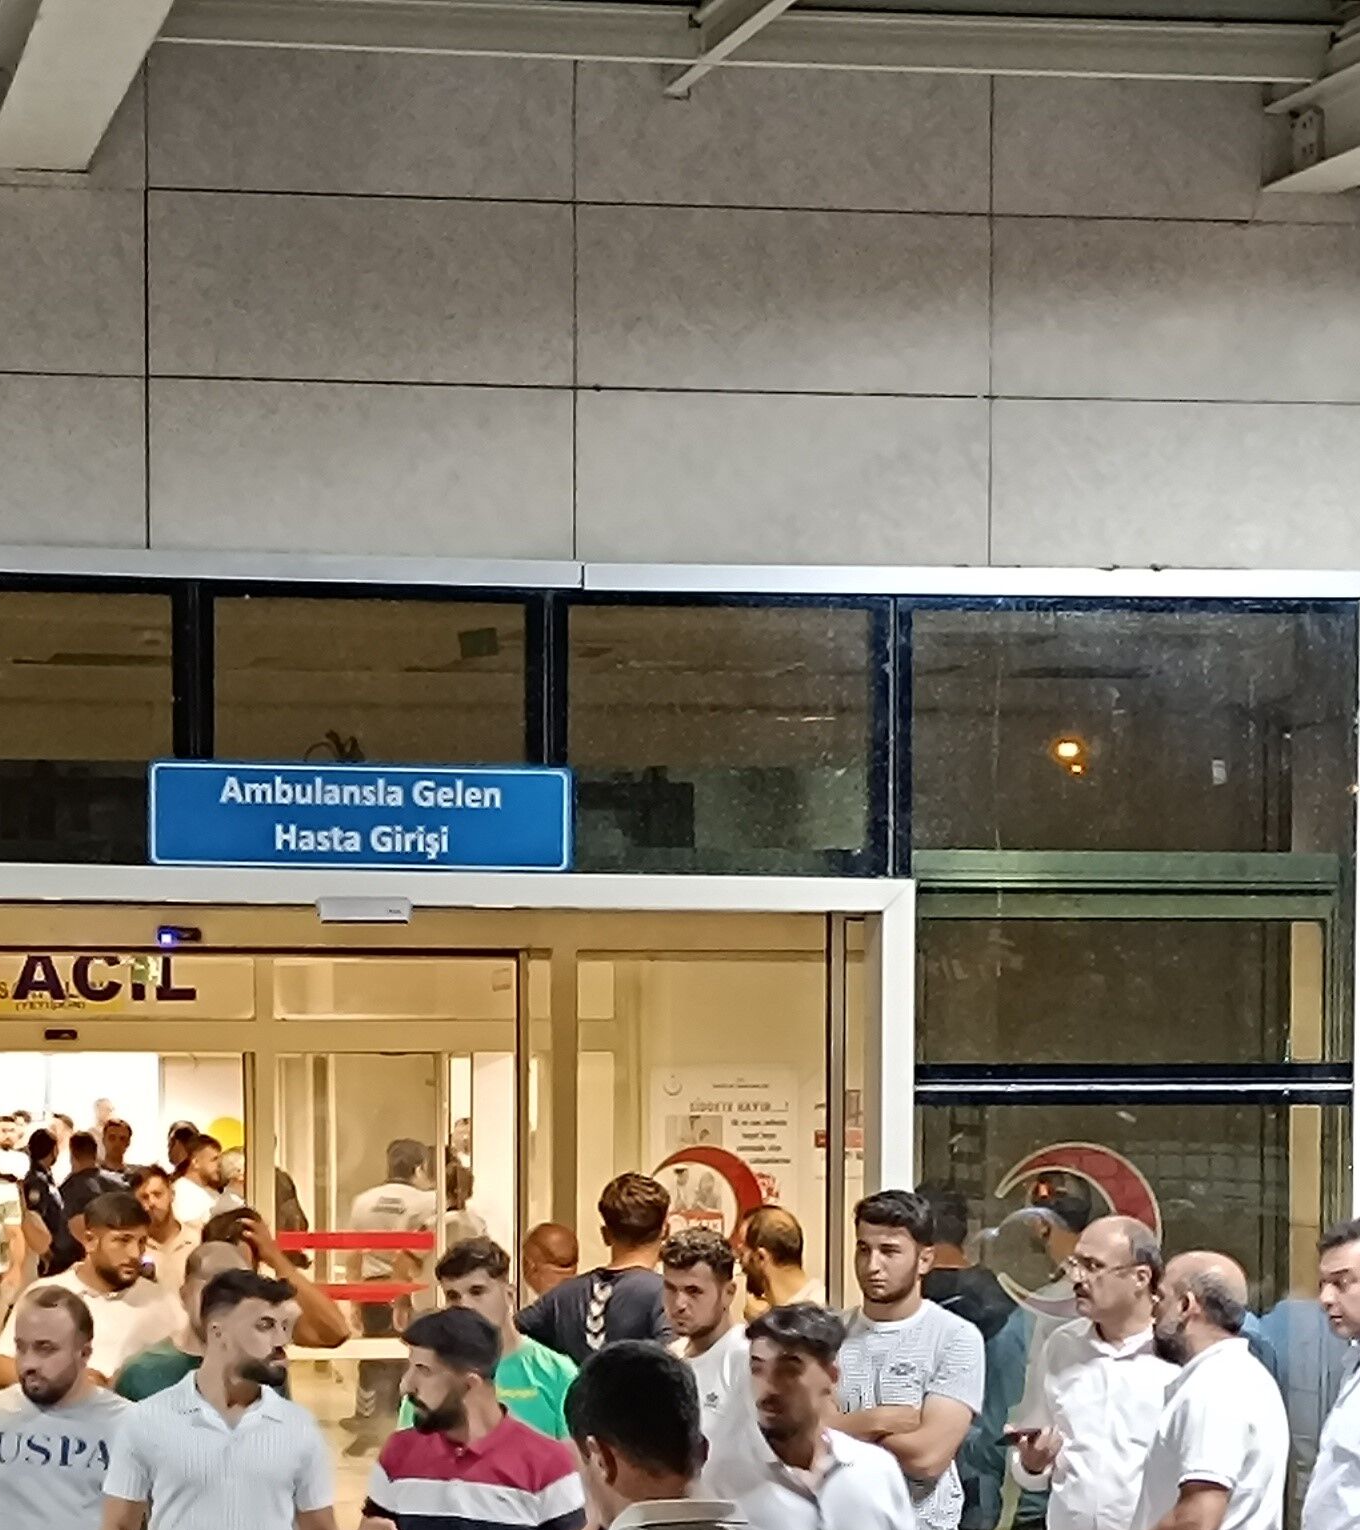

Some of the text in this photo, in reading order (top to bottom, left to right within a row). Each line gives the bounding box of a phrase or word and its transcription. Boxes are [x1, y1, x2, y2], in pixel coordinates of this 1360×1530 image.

[219, 775, 502, 809] Ambulansla Gelen
[274, 823, 449, 860] Hasta Girişi
